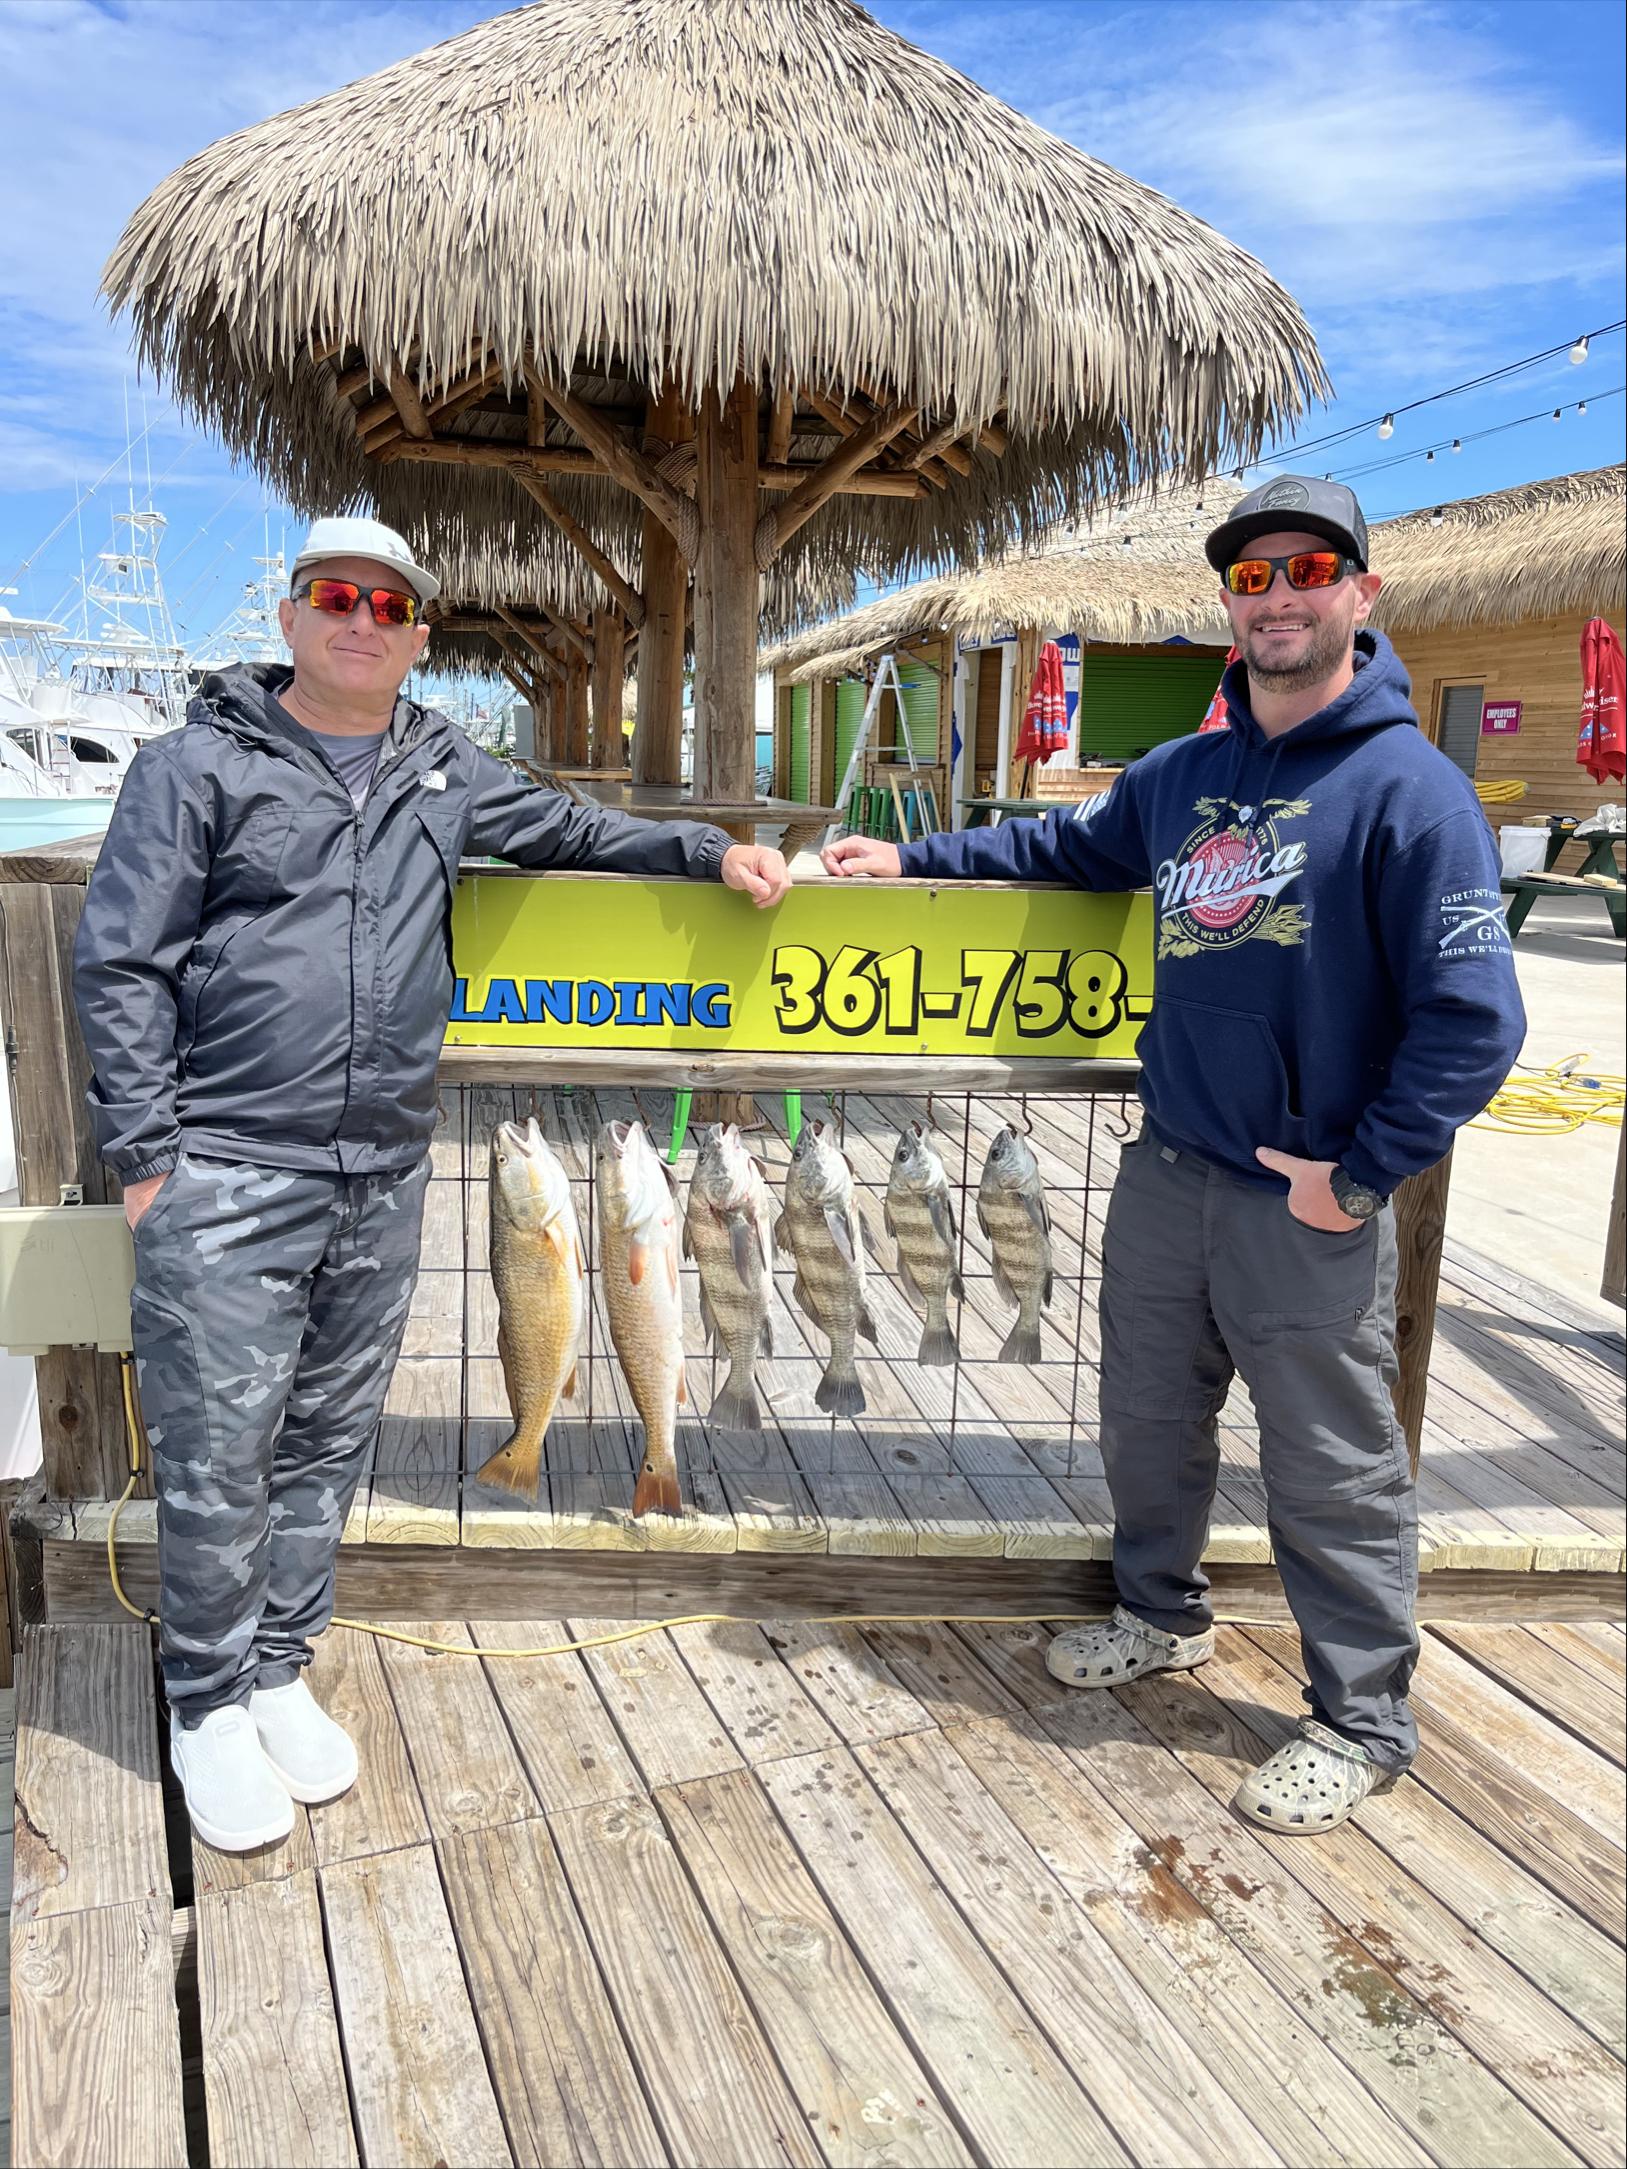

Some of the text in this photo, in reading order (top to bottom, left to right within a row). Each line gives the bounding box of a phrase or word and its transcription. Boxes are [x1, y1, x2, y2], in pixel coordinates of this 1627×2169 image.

[1486, 707, 1517, 719] EMPLOYEES
[1493, 718, 1508, 729] ONLY
[1187, 826, 1269, 854] SINCE 1776
[1156, 841, 1308, 912] Murica
[1441, 888, 1488, 905] GRUNT
[1180, 899, 1265, 941] THIS WE'LL DEFEND
[1442, 915, 1460, 926] US
[1477, 925, 1501, 942] GS
[1438, 947, 1466, 958] THIS
[1468, 945, 1498, 953] WE'LL
[450, 944, 1154, 1039] LANDING 361-758-
